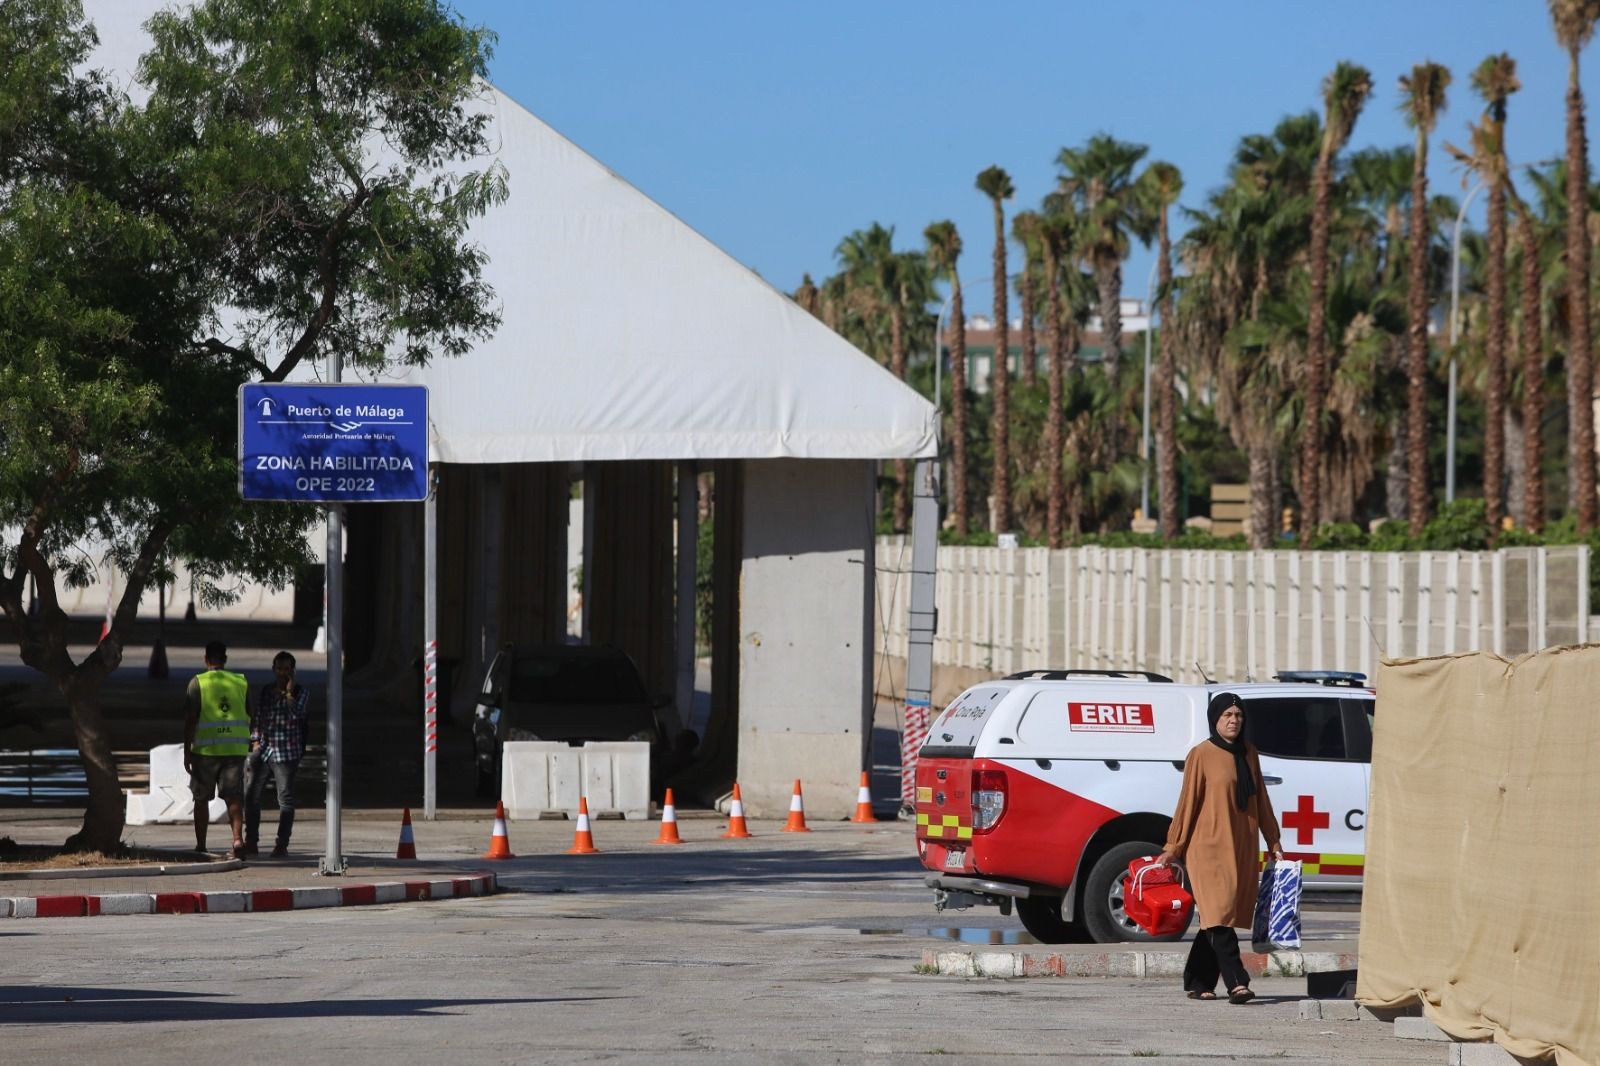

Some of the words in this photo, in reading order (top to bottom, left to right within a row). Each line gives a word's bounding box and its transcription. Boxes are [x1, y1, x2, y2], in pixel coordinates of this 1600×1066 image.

[287, 404, 331, 417] Puerto
[335, 404, 352, 417] de
[355, 404, 404, 420] Málaga
[302, 432, 333, 440] Autoridad
[256, 456, 306, 471] ZONA
[310, 456, 414, 471] HABILITADA
[296, 477, 332, 492] OPE
[336, 477, 375, 492] 2022
[1080, 704, 1142, 725] ERIE
